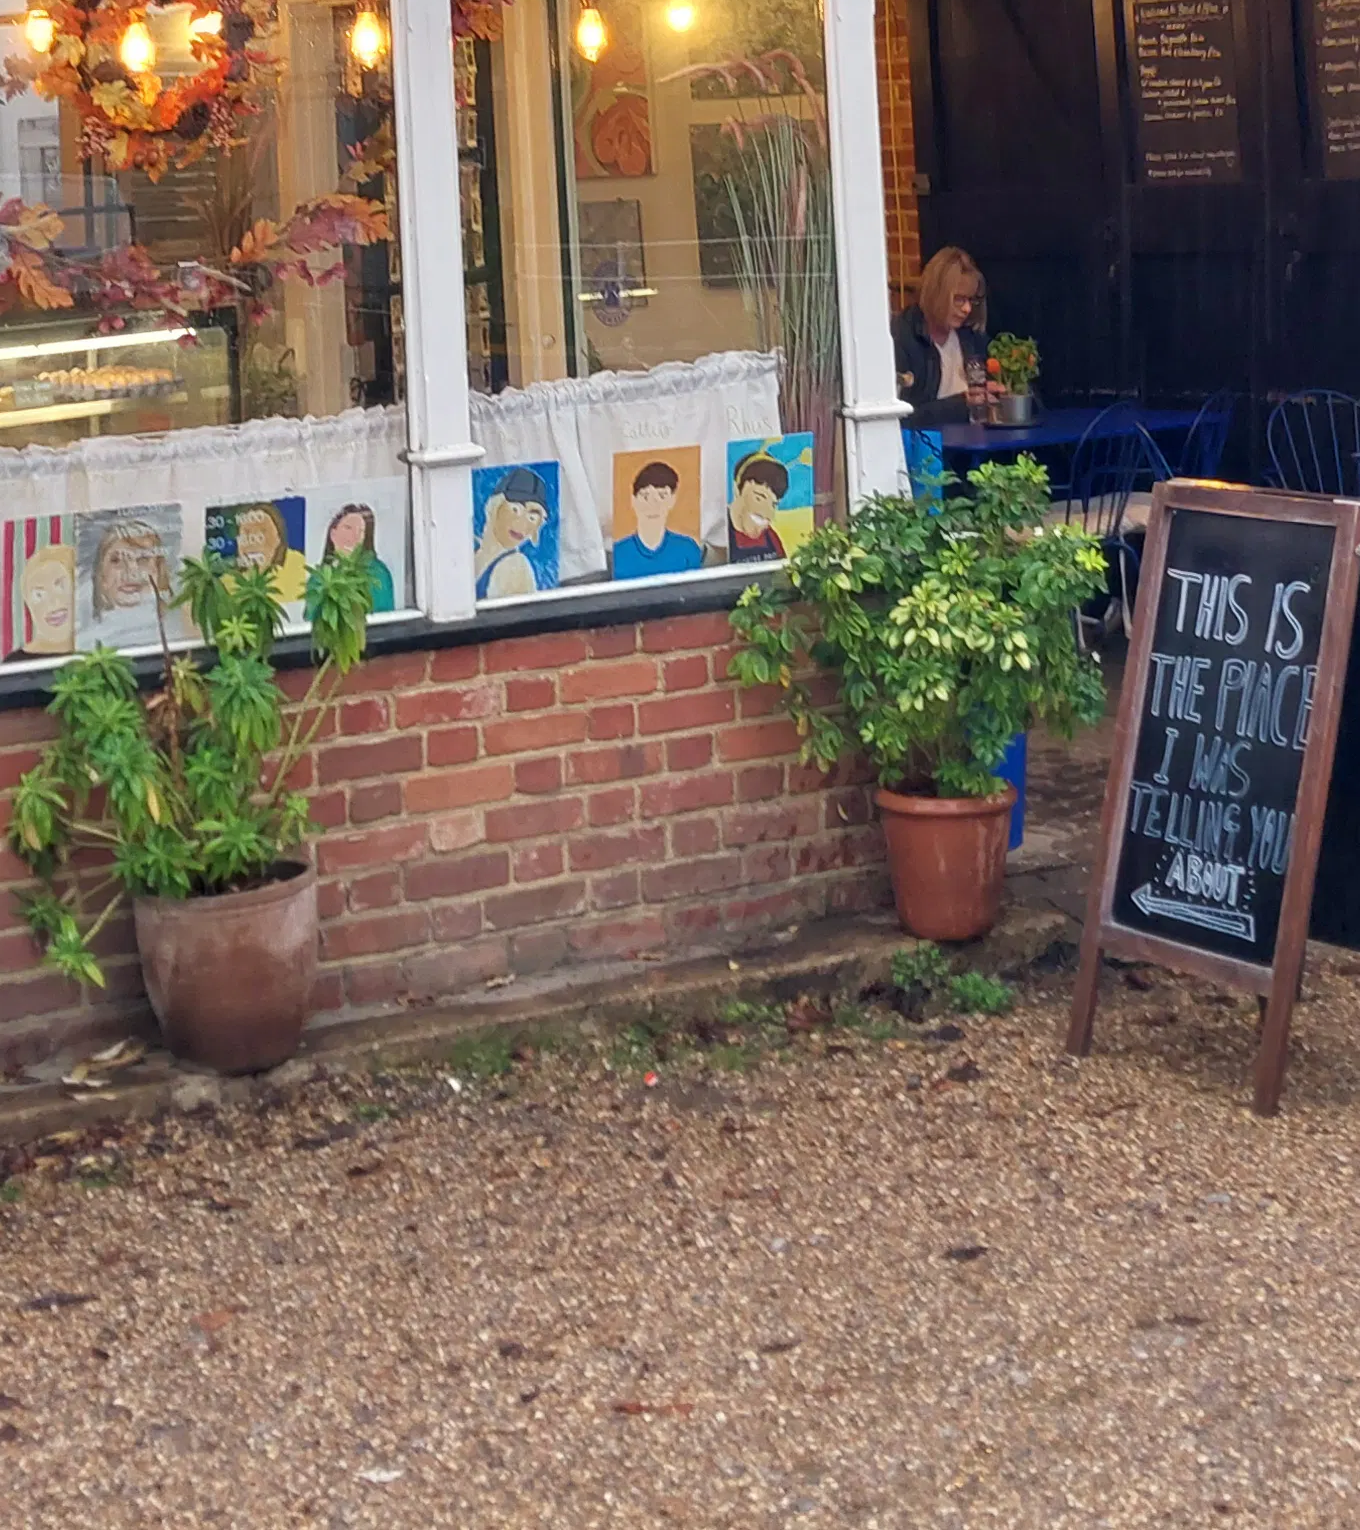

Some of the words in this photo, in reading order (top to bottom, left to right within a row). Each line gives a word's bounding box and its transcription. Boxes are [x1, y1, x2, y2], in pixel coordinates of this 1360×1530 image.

[1167, 567, 1252, 646] THIS
[1264, 580, 1311, 661] IS
[1150, 652, 1211, 724] THE
[1153, 726, 1180, 785] I
[1189, 732, 1251, 798] WAS
[1130, 780, 1241, 861] TELLING
[1247, 805, 1296, 875] YOU
[1165, 851, 1246, 907] ABOUT
